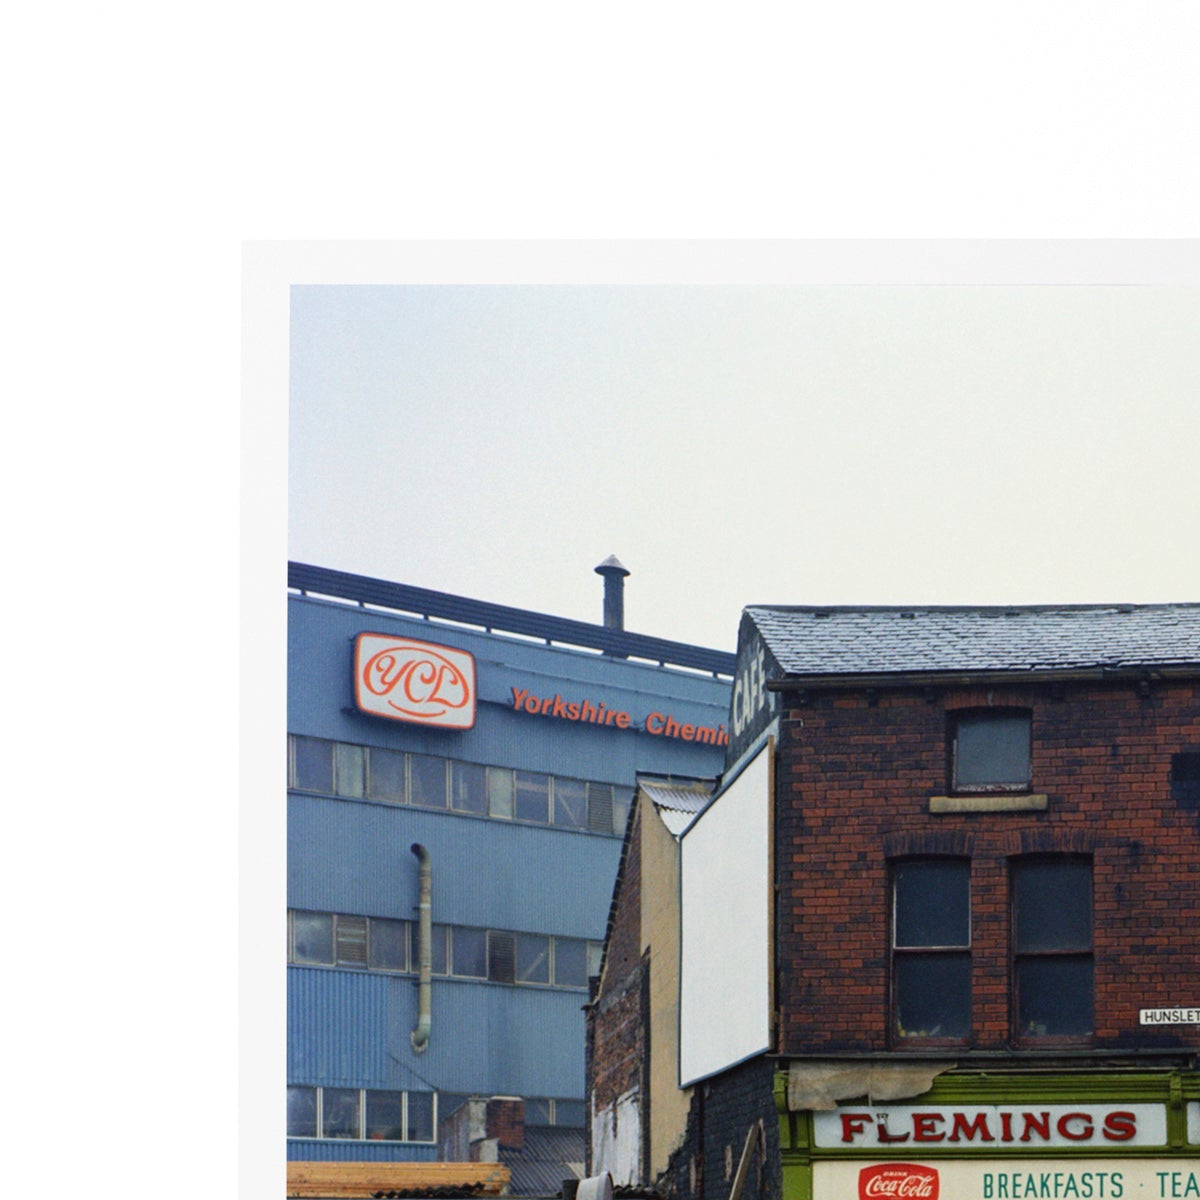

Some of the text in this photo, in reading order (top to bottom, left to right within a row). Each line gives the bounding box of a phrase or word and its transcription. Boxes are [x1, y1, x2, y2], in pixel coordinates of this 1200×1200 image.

[511, 686, 631, 728] Yorkshire
[840, 1111, 1138, 1144] FLEMINGS
[865, 1174, 935, 1197] Coca-Cola
[983, 1172, 1124, 1199] BREAKFASTS
